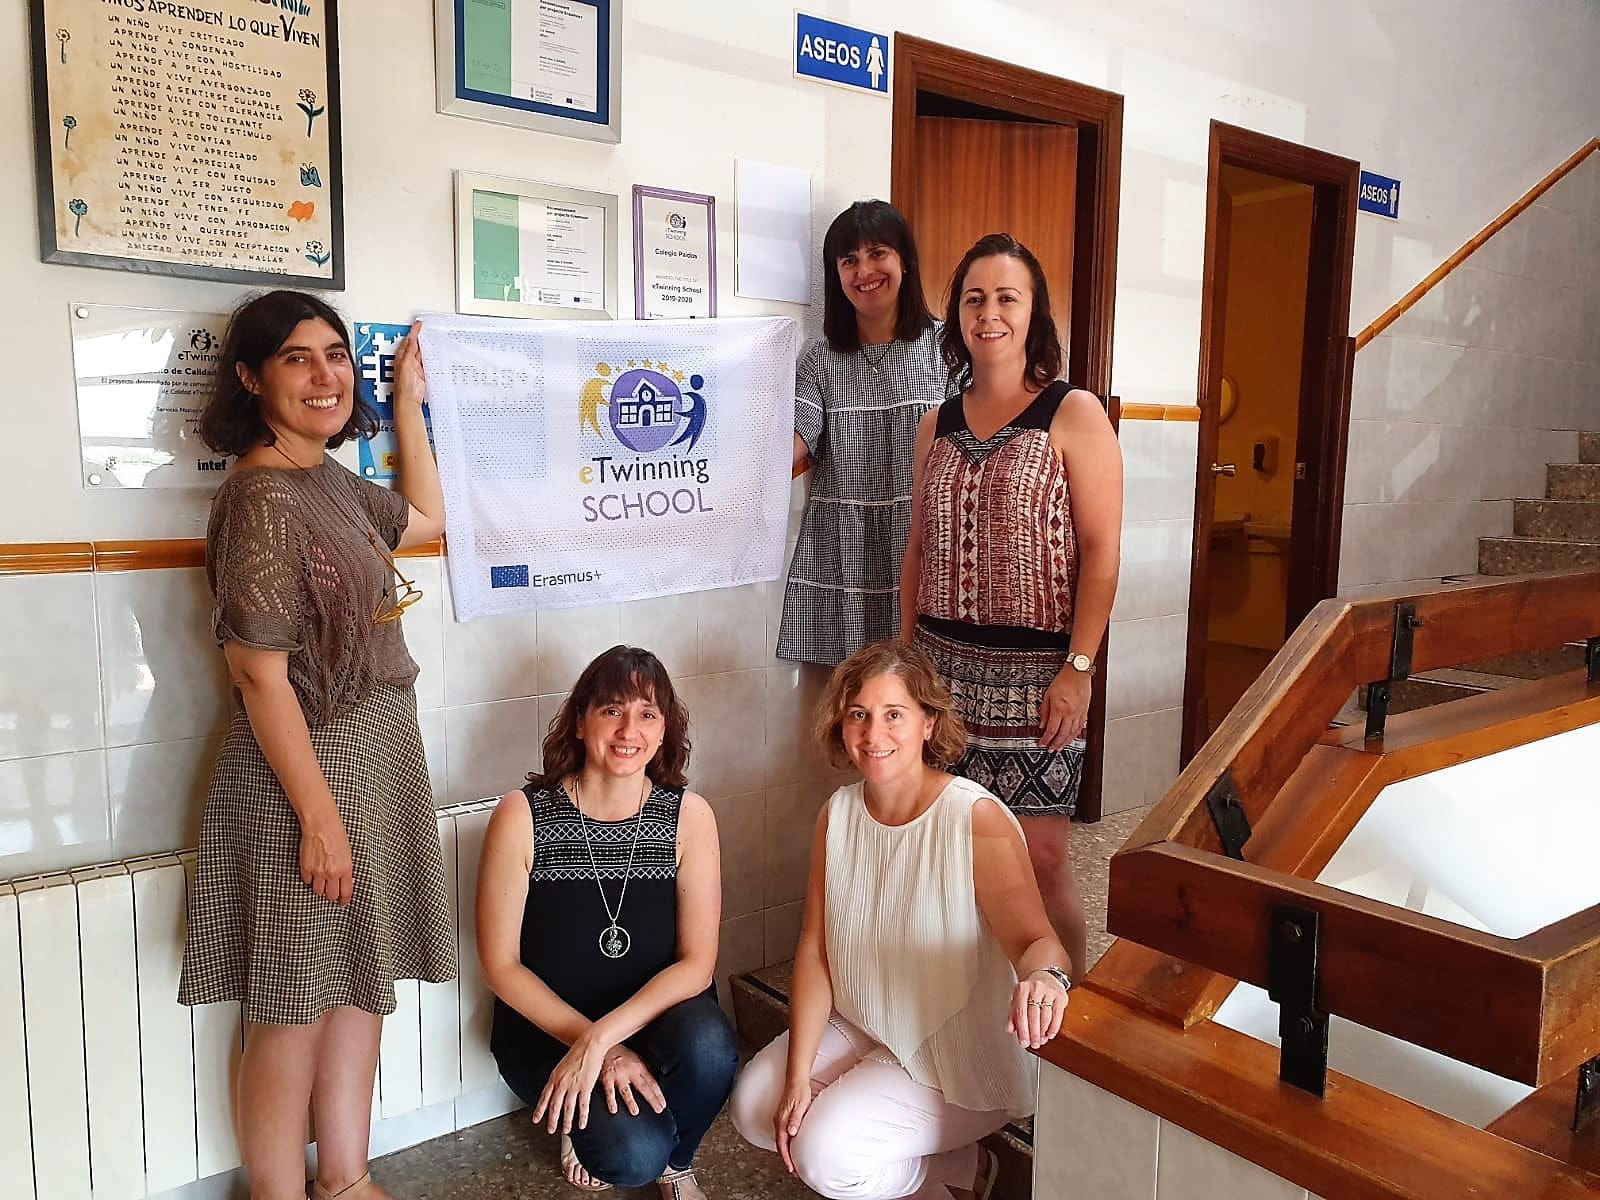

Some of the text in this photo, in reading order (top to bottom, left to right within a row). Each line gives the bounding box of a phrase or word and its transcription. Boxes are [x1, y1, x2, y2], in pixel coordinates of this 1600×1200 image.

[148, 0, 223, 26] APRENDEN
[228, 15, 246, 31] LO
[250, 19, 281, 38] QUE
[108, 15, 120, 23] UN
[158, 24, 183, 35] VIVE
[190, 31, 245, 48] CRITICADO
[113, 27, 159, 42] APRENDE
[182, 41, 236, 57] CONDENAR
[109, 39, 122, 47] UN
[163, 49, 190, 60] VIVE
[197, 56, 215, 65] CON
[222, 60, 282, 78] HOSTILIDAD
[800, 34, 861, 69] ASEOS
[110, 62, 123, 70] UN
[166, 72, 192, 83] VIVE
[115, 51, 163, 66] APRENDE
[185, 64, 222, 77] PELEAR
[111, 85, 124, 93] UN
[166, 94, 192, 105] VIVE
[198, 100, 217, 110] CON
[222, 104, 283, 122] TOLERANCIA
[115, 75, 161, 89] APRENDE
[178, 86, 227, 101] SENTIRSE
[234, 97, 281, 111] CULPABLE
[117, 98, 162, 112] APRENDE
[182, 109, 200, 119] SER
[206, 113, 263, 130] TOLERANTE
[168, 117, 194, 128] VIVE
[200, 122, 217, 132] CON
[119, 122, 163, 136] APRENDE
[115, 133, 128, 142] UN
[169, 142, 196, 152] VIVE
[203, 147, 258, 161] APRECIADO
[121, 147, 166, 160] APRENDE
[192, 157, 241, 170] APRECIAR
[116, 158, 129, 166] UN
[172, 165, 199, 175] VIVE
[207, 170, 226, 179] CON
[234, 174, 276, 186] EQUIDAD
[122, 171, 168, 183] APRENDE
[192, 180, 210, 188] SER
[220, 184, 252, 194] JUSTO
[118, 182, 131, 190] UN
[171, 188, 196, 199] VIVE
[204, 193, 223, 202] CON
[230, 196, 284, 209] SEGURIDAD
[124, 194, 170, 207] APRENDE
[1360, 183, 1388, 204] ASEOS
[119, 206, 132, 214] UN
[174, 212, 199, 222] VIVE
[207, 216, 226, 225] CON
[121, 230, 135, 238] UN
[175, 234, 201, 245] VIVE
[208, 239, 227, 248] CON
[125, 219, 171, 230] APRENDE
[199, 226, 249, 239] QUERERSE
[180, 248, 224, 258] APRENDE
[654, 248, 677, 257] Colegio
[652, 283, 702, 295] eTwinning School
[171, 367, 182, 375] de
[184, 367, 217, 376] Calidad
[197, 458, 227, 471] intef
[578, 454, 710, 486] eTwinning
[582, 487, 714, 523] SCHOOL
[533, 567, 602, 588] Erasmus+
